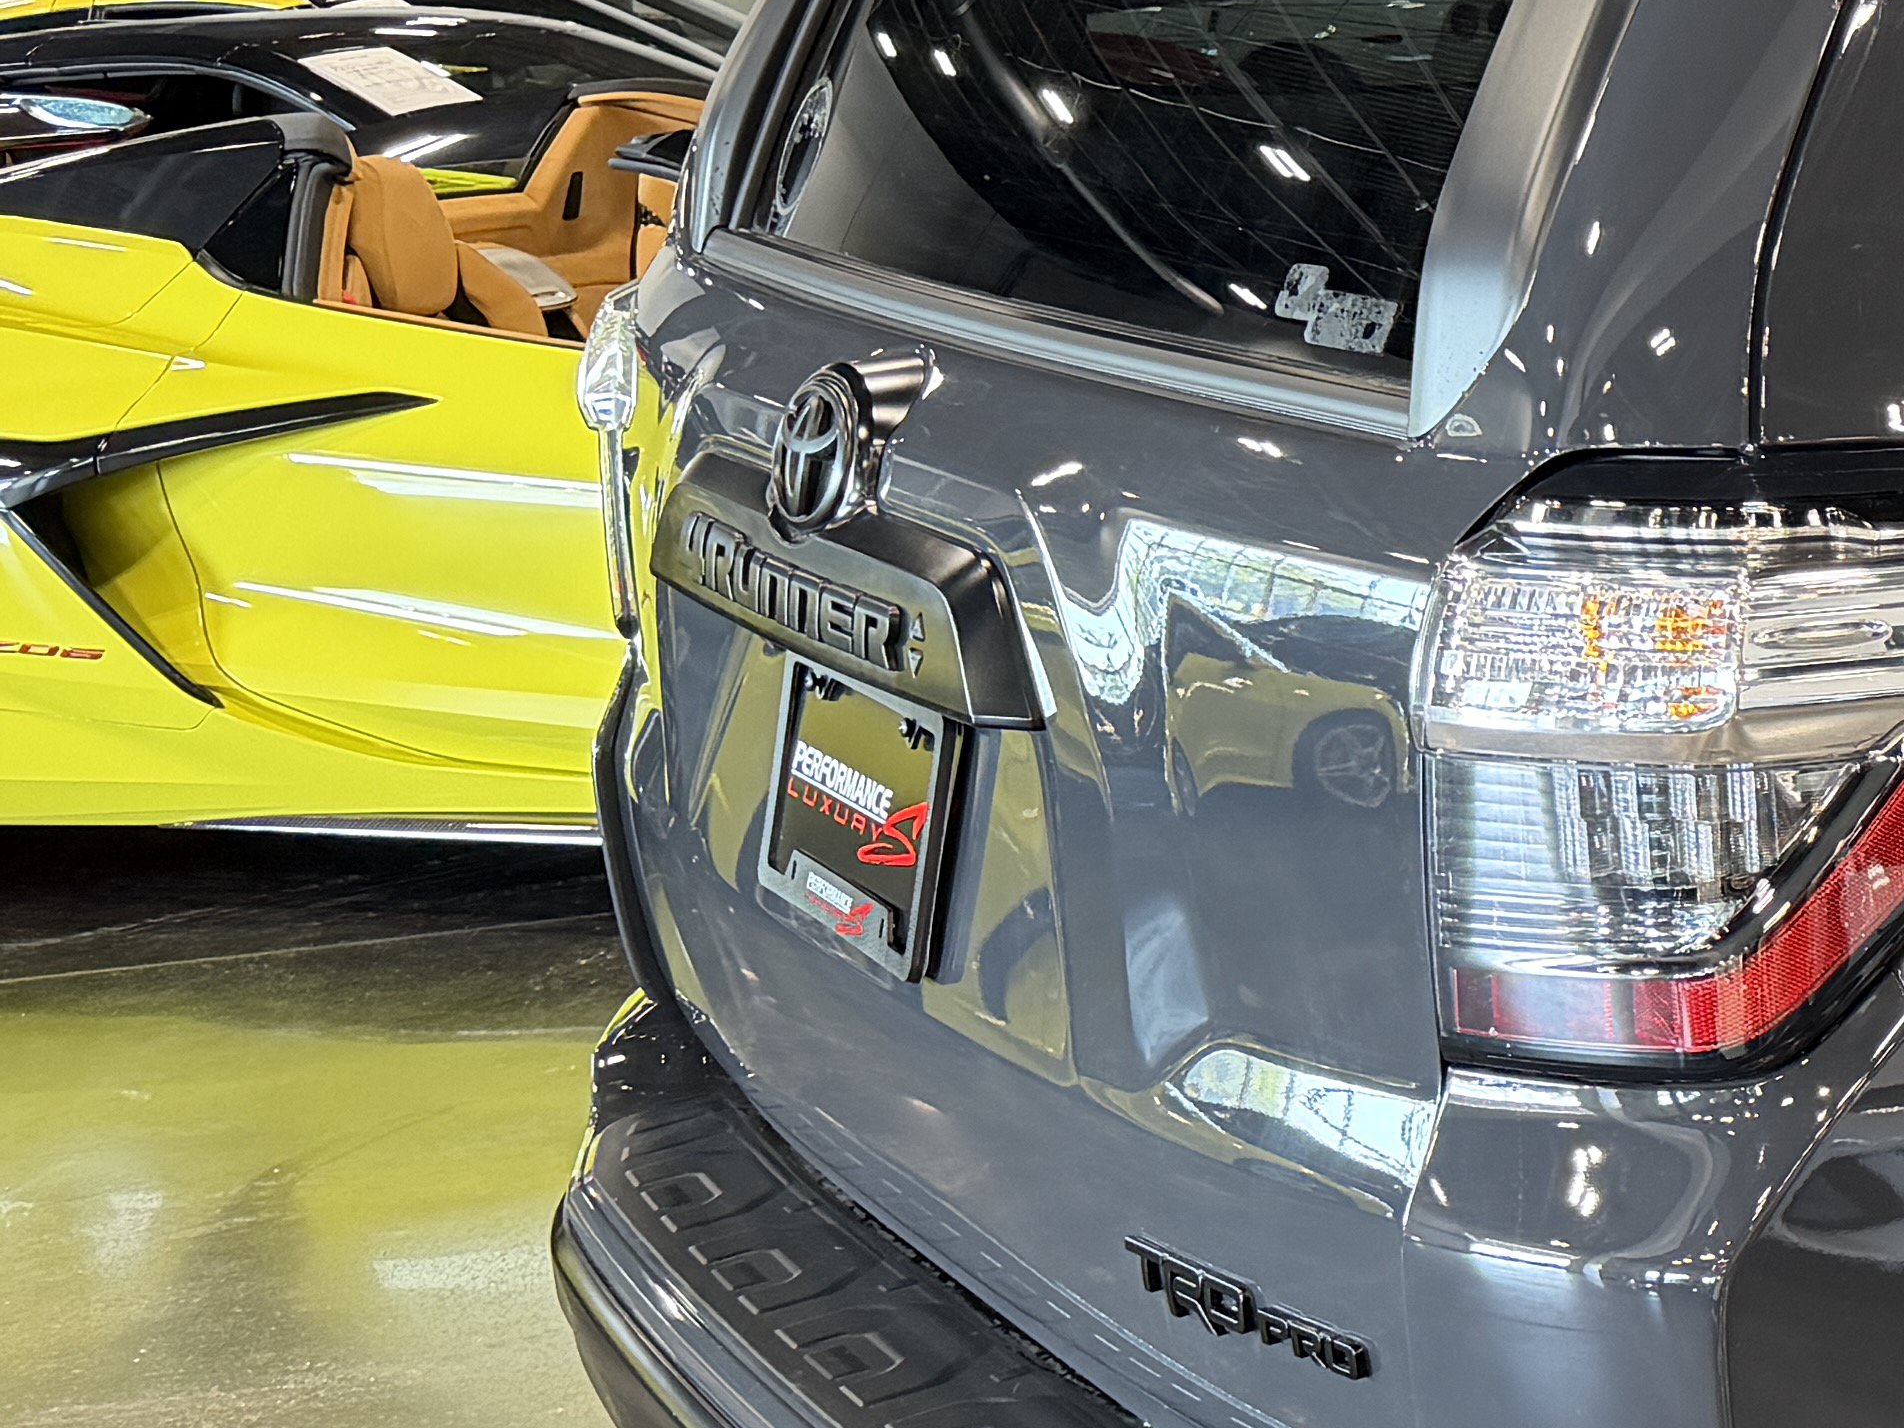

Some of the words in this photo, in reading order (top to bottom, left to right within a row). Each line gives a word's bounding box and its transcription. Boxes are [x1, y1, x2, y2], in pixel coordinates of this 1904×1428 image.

[682, 511, 902, 671] 4RUNNER
[787, 778, 884, 842] LUXURY
[791, 740, 894, 819] PERFORMANCE
[1124, 1234, 1257, 1337] TRD
[1256, 1304, 1373, 1380] PRO
